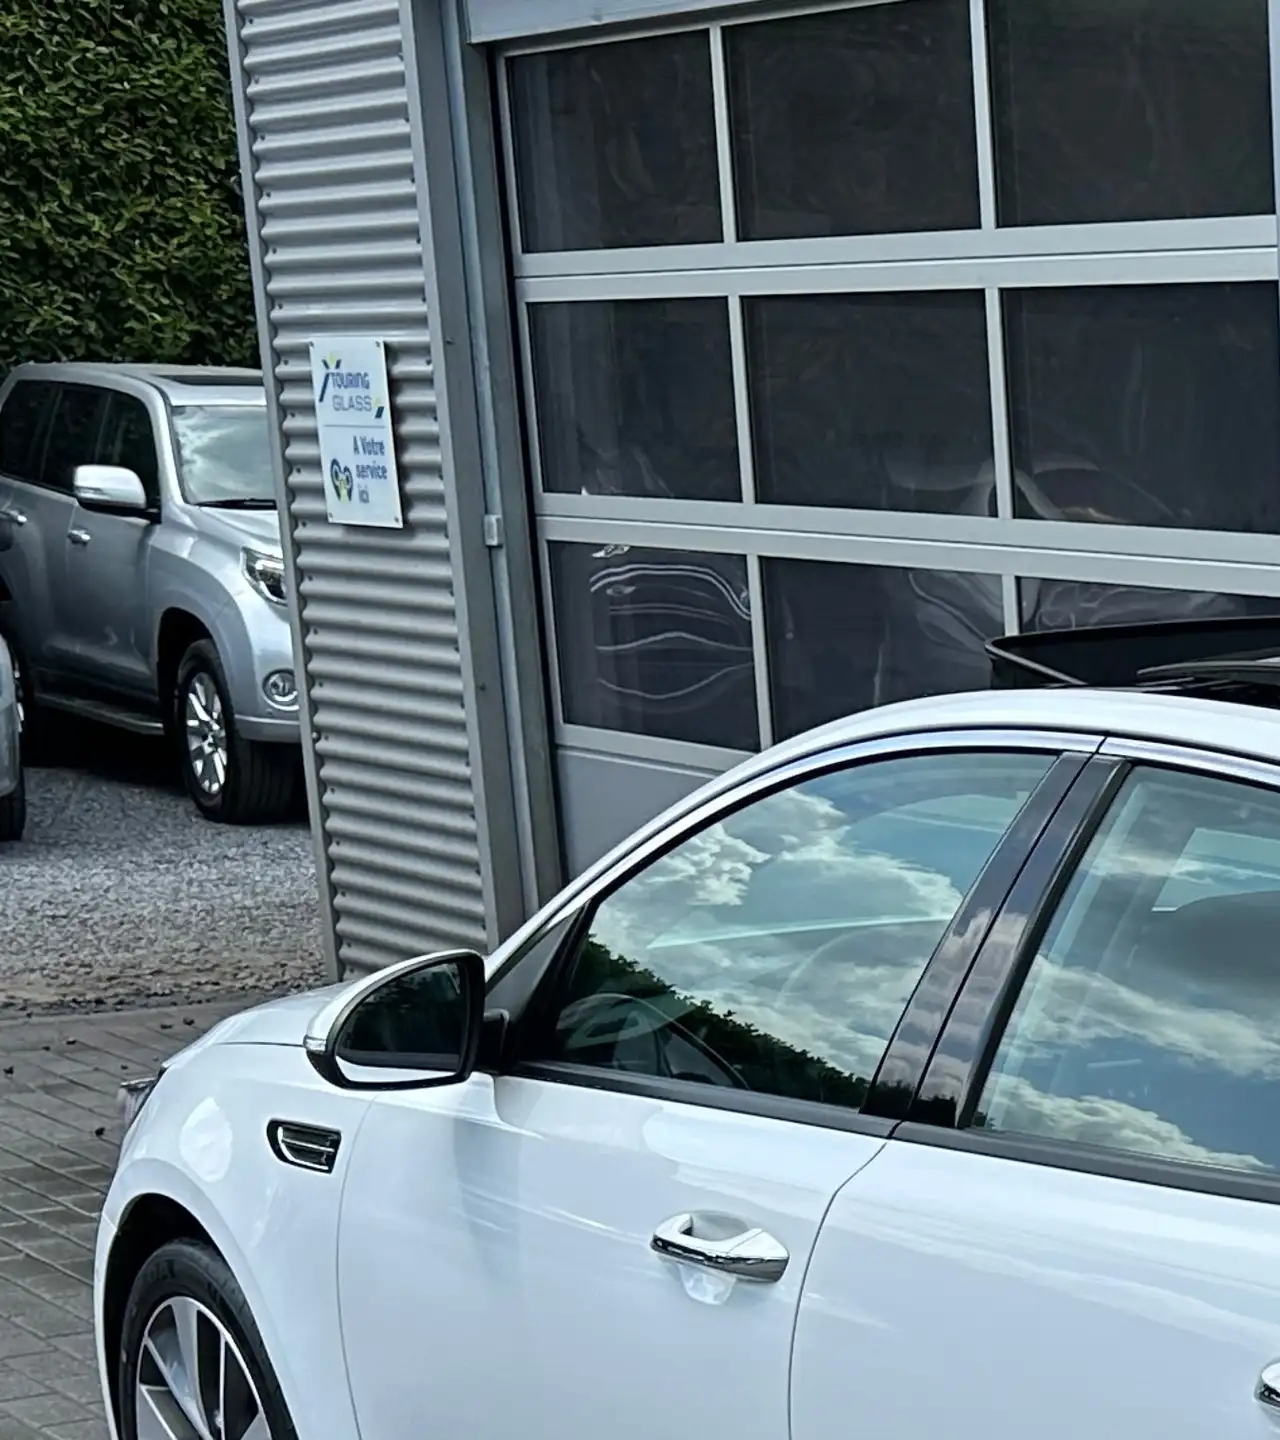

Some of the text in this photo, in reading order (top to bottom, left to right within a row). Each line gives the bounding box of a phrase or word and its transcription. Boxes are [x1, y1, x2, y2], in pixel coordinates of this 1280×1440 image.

[331, 371, 370, 390] TOURING
[332, 395, 373, 412] GLASS
[356, 461, 387, 480] service
